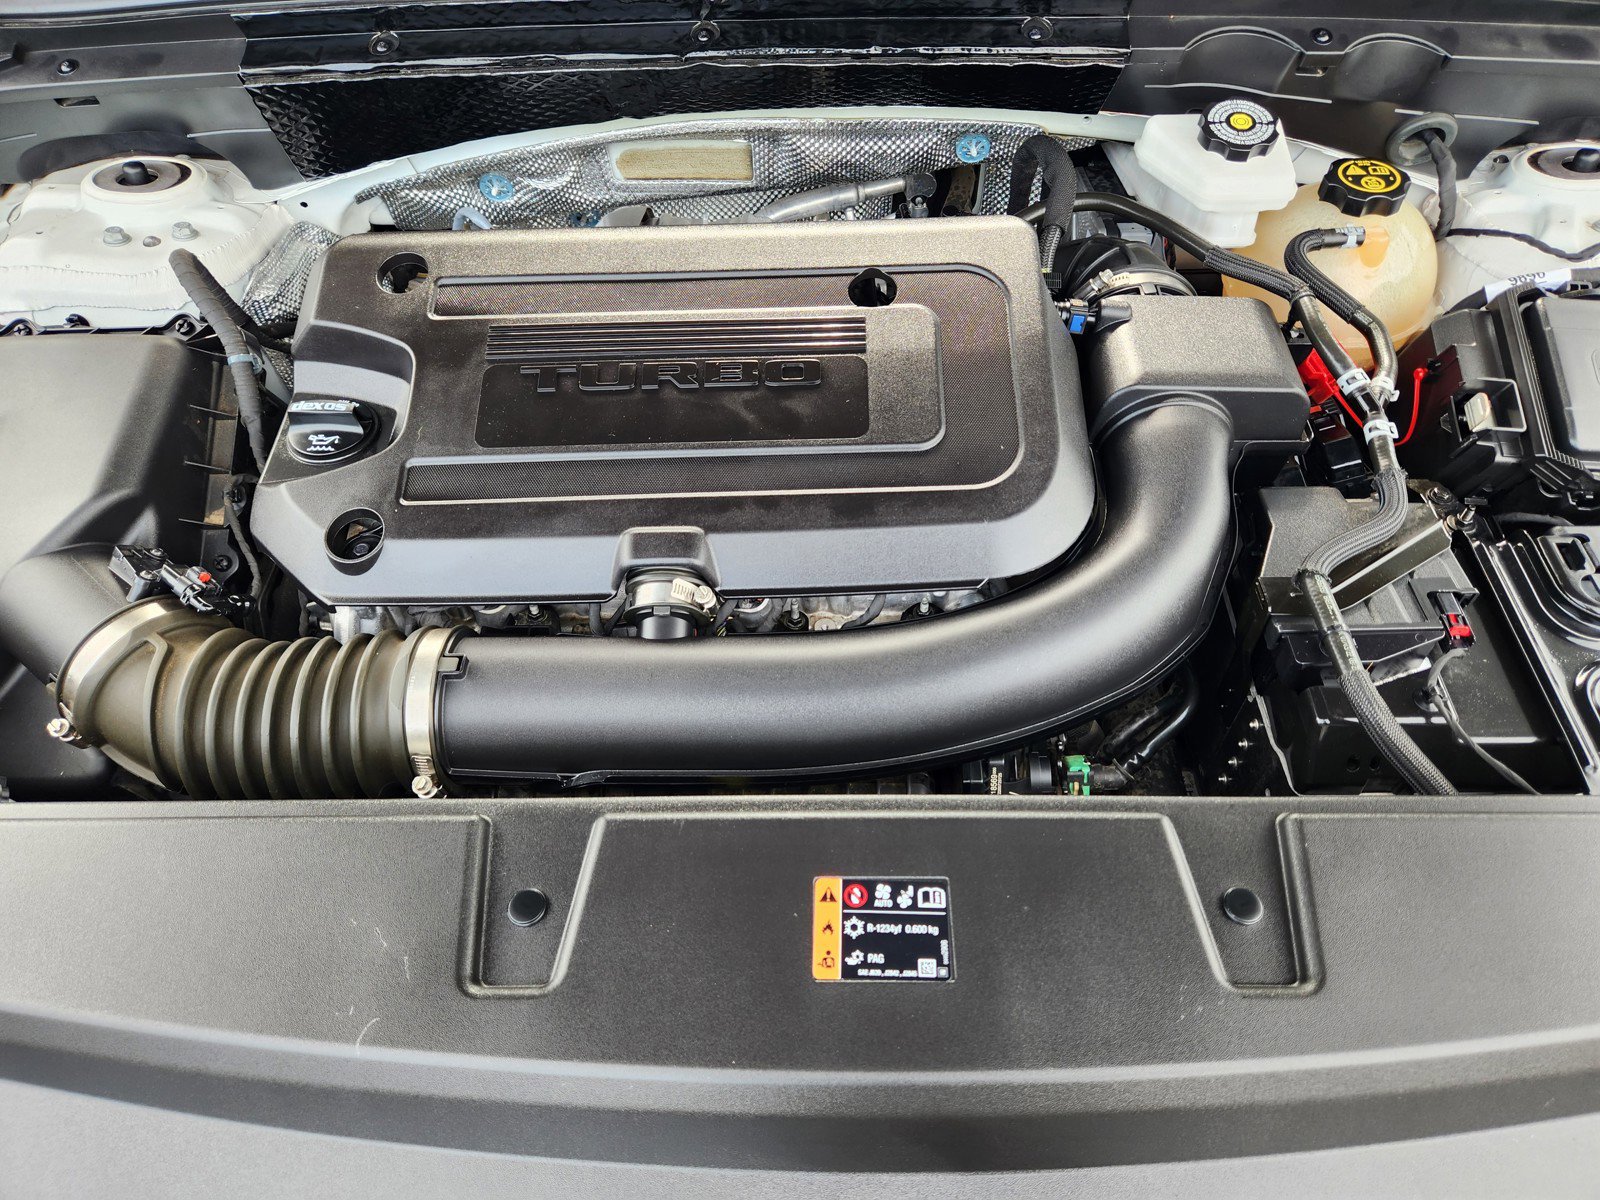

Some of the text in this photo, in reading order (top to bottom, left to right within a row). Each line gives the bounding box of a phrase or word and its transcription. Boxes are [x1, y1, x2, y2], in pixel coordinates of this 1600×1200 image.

[519, 359, 822, 393] TURBO
[290, 400, 347, 412] dexos
[873, 899, 893, 908] AUTO
[866, 923, 939, 936] R-1234yf 0.600 kg
[867, 953, 885, 964] PAG
